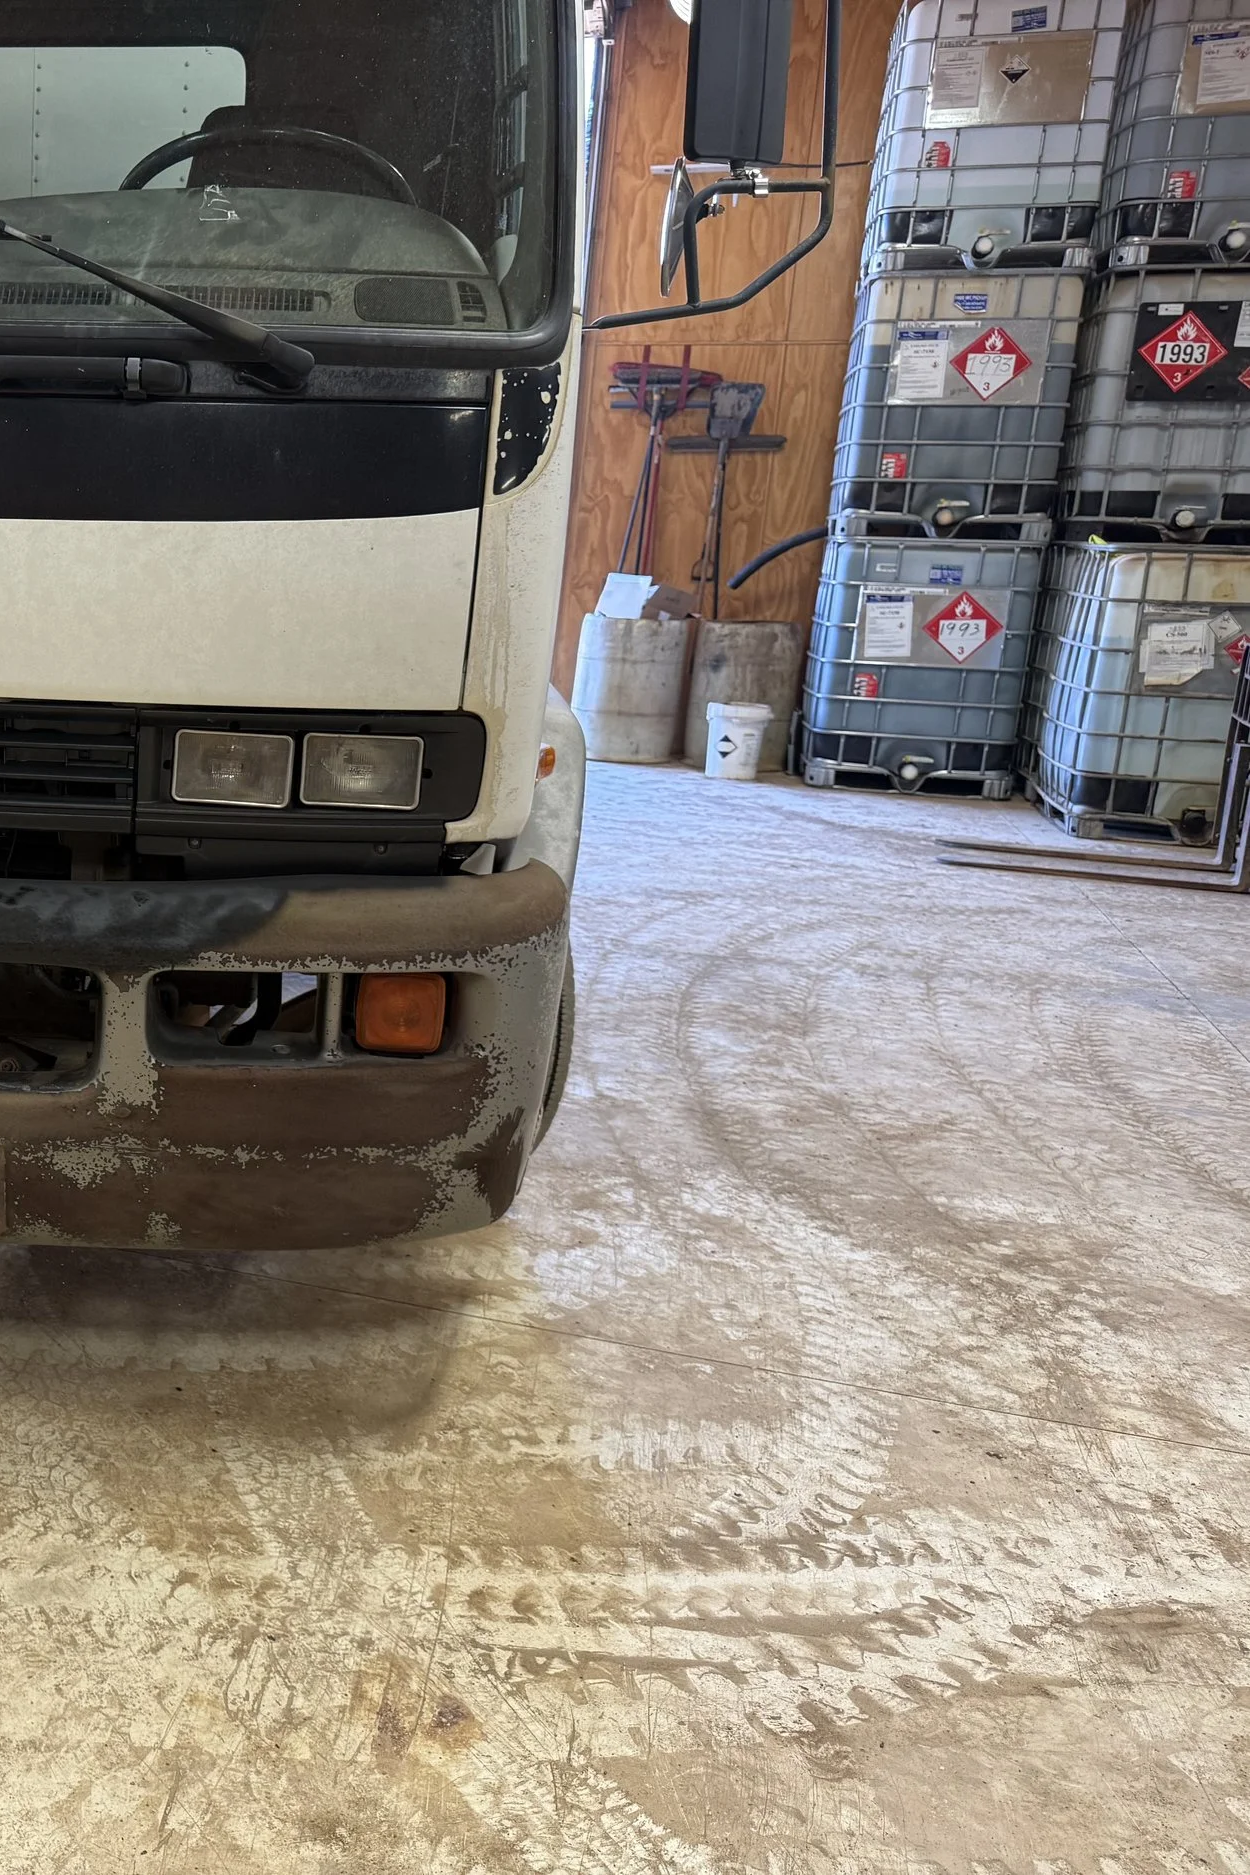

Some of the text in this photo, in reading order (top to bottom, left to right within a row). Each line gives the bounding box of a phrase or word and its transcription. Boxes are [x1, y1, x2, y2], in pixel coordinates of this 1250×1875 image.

[1159, 343, 1207, 364] 1993
[966, 355, 1013, 376] 1993
[1173, 372, 1182, 383] 3
[982, 382, 991, 392] 3
[940, 622, 981, 637] 1993
[957, 646, 965, 655] 3
